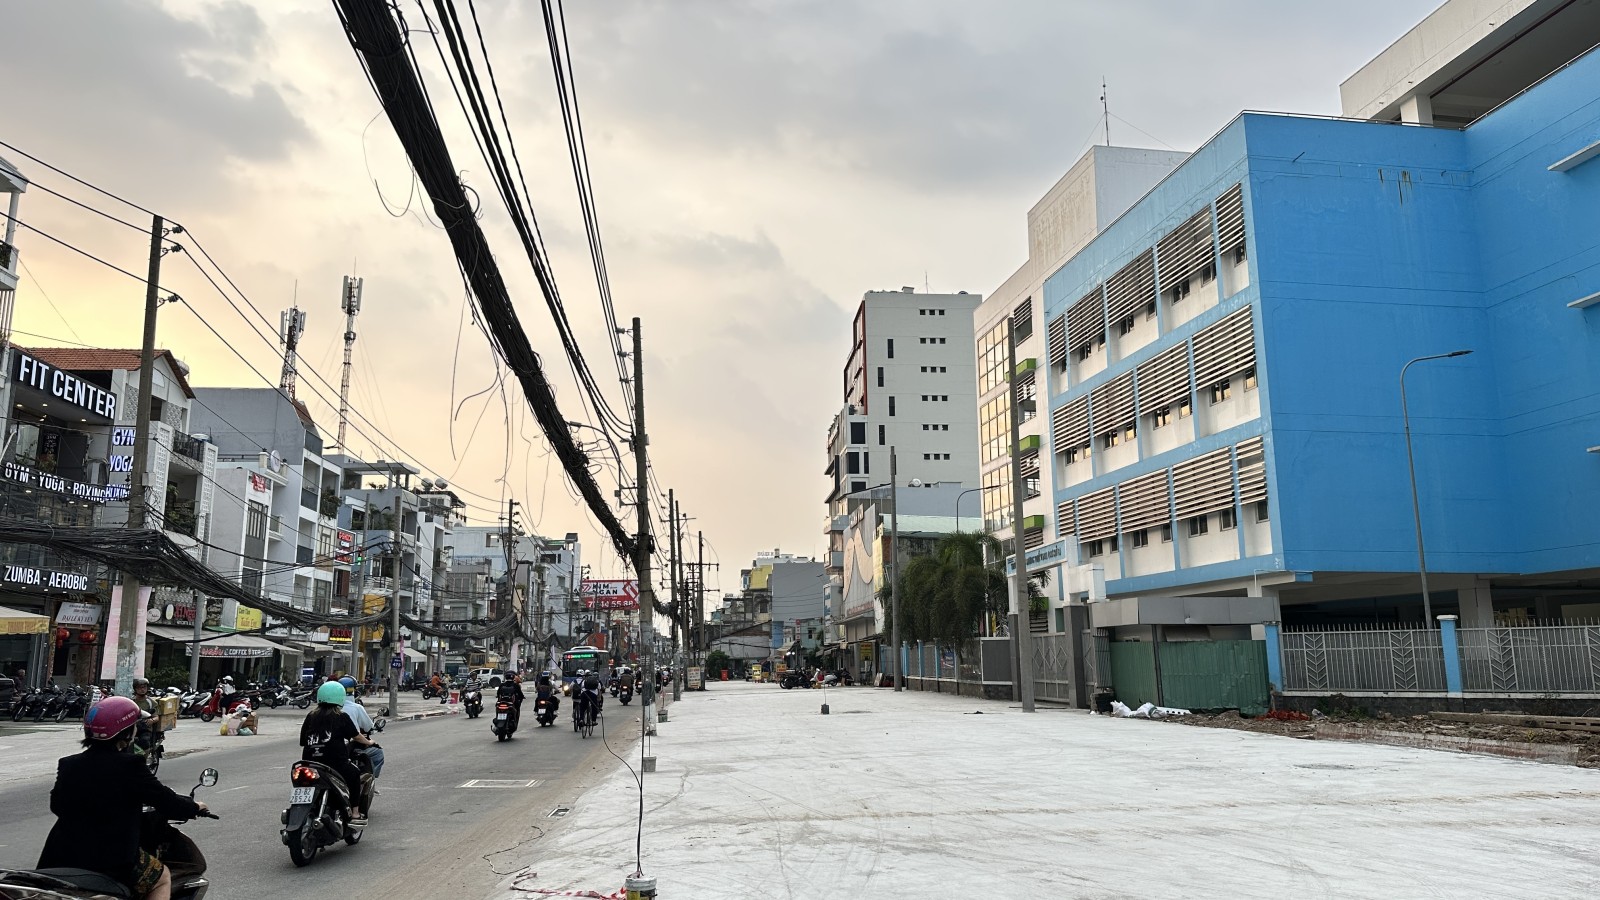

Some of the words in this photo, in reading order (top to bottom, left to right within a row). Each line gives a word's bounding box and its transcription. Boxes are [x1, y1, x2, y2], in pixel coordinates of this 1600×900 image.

[19, 354, 50, 390] FIT
[52, 369, 116, 420] CENTER
[5, 462, 30, 484] GYM
[39, 472, 65, 493] YOGA
[4, 565, 41, 585] ZUMBA
[48, 571, 88, 591] AEROBIC
